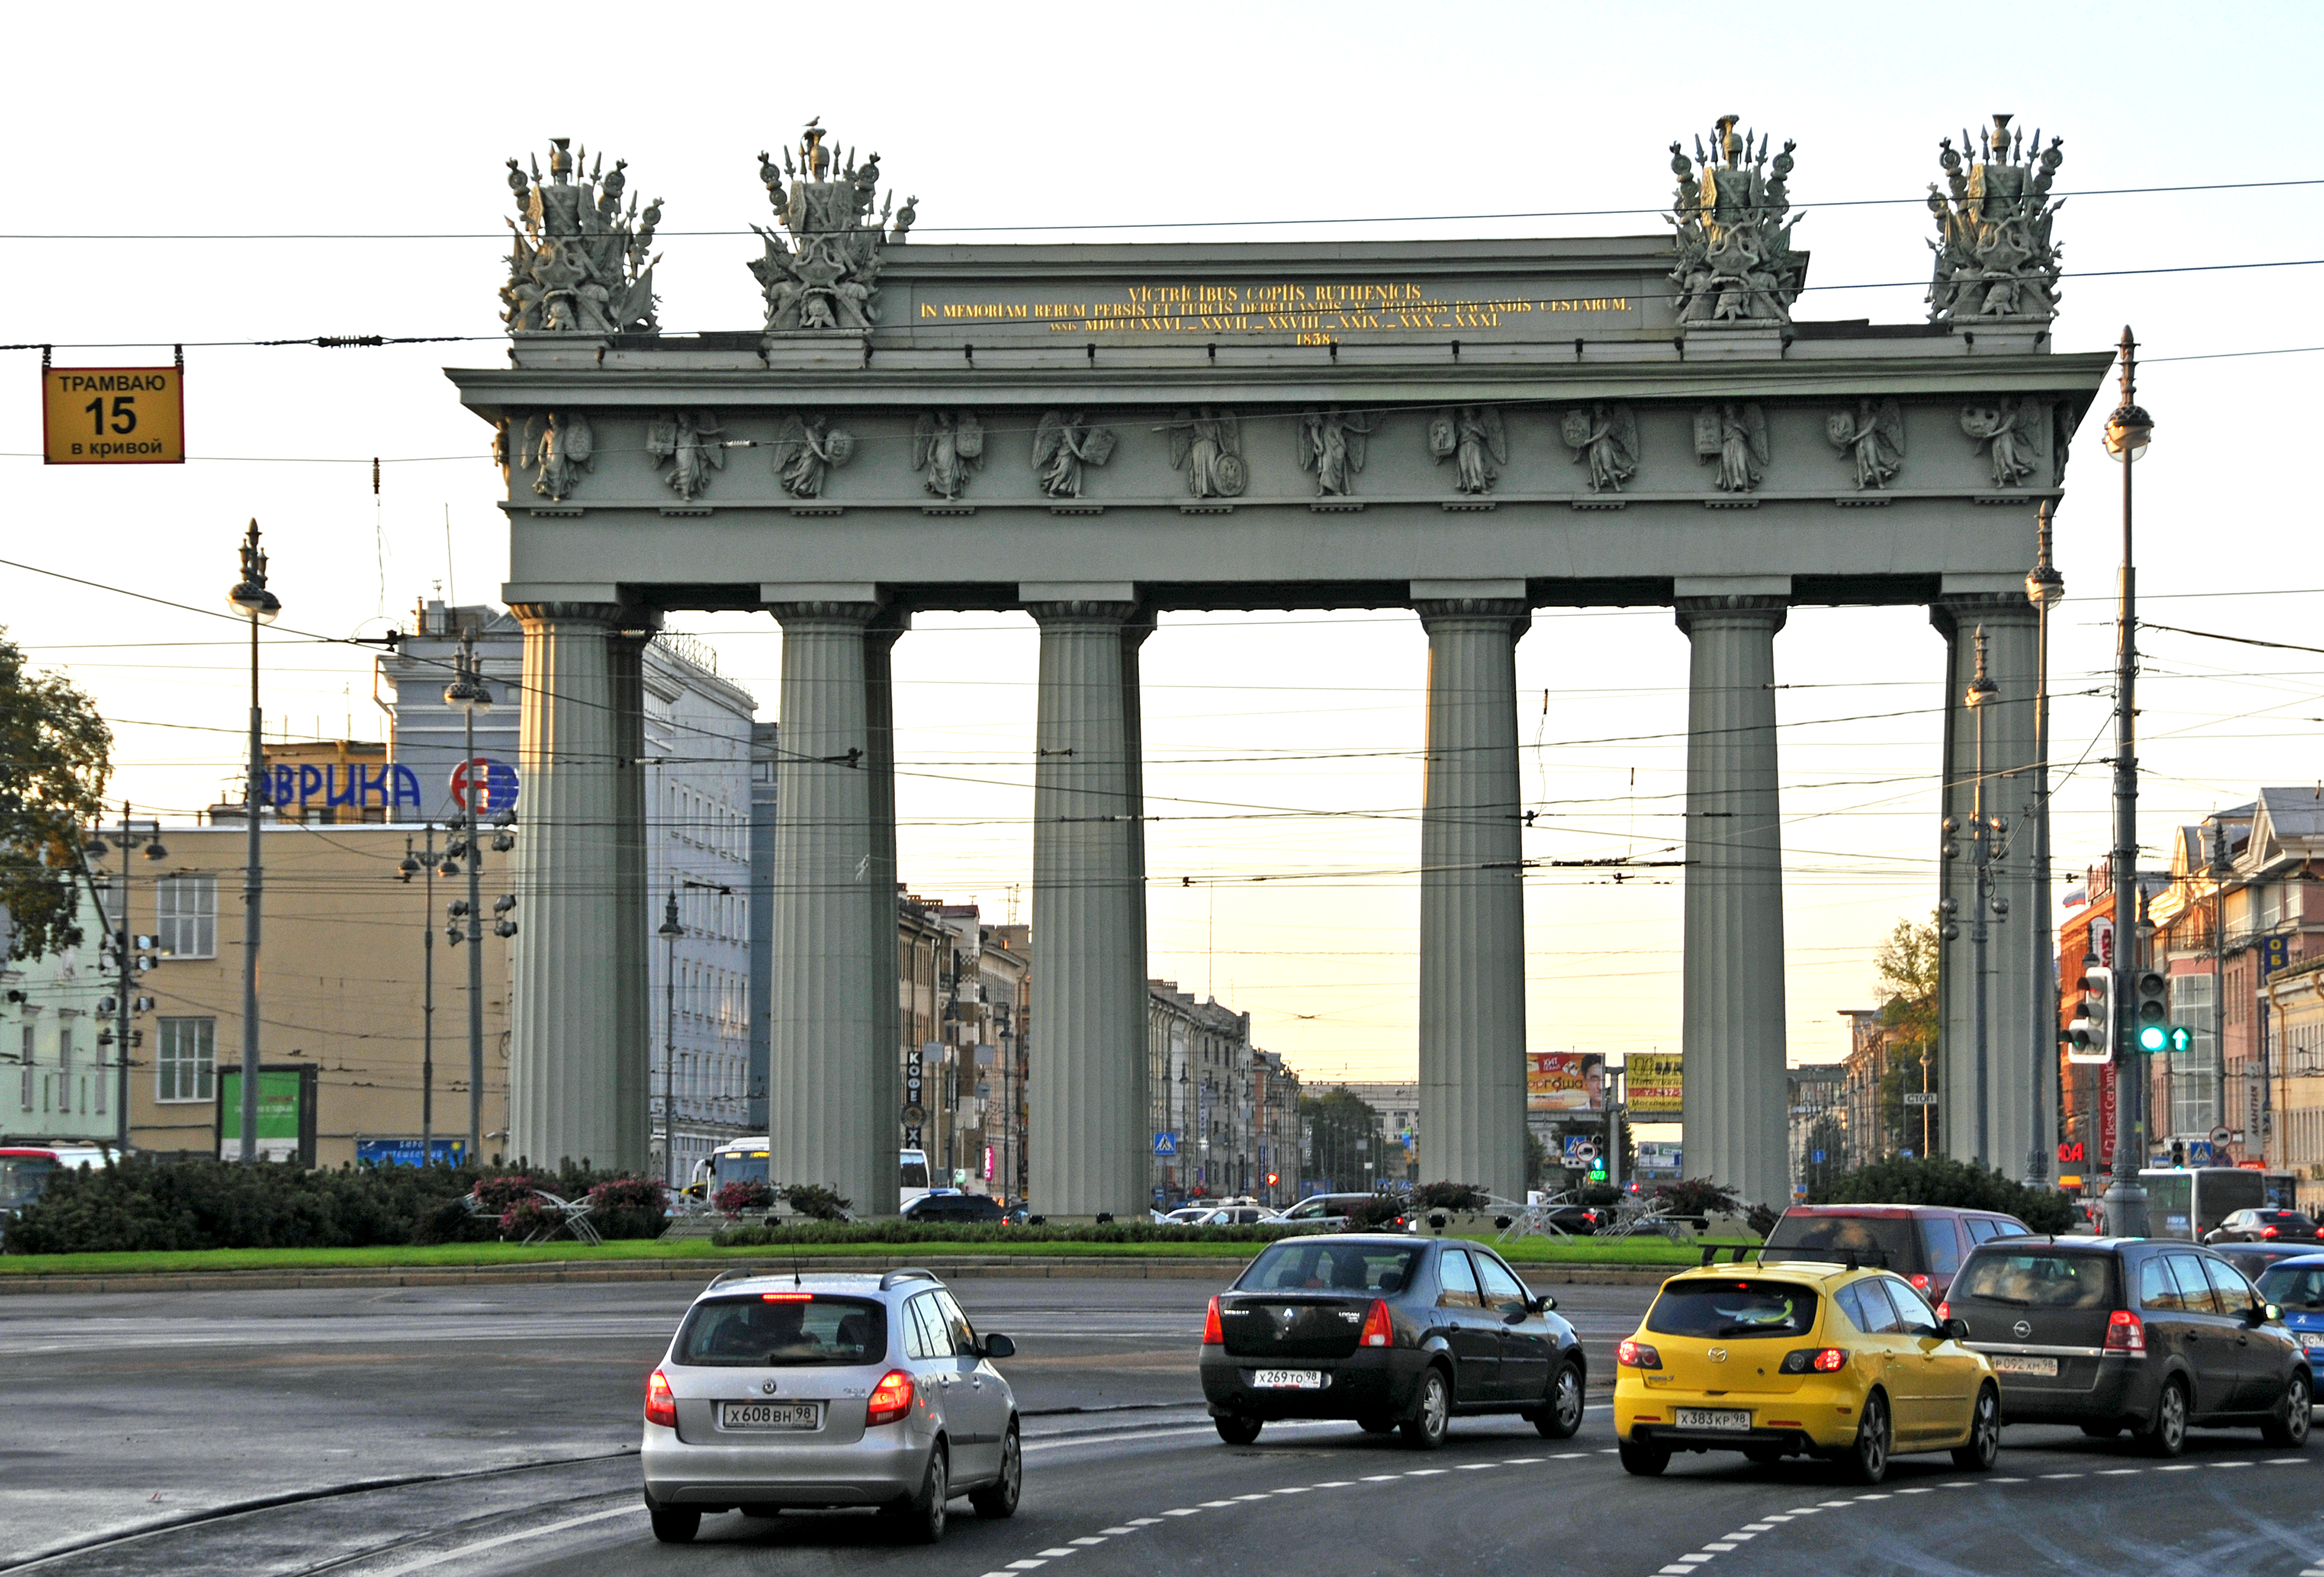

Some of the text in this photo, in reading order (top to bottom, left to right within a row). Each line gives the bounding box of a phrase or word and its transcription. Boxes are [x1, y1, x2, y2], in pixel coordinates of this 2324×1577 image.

[1315, 283, 1422, 300] RUTHENICIS
[920, 303, 937, 318] IN
[943, 302, 1028, 318] MEMORIAM
[1034, 304, 1086, 317] RERUM
[1093, 302, 1145, 317] PERSIS
[1152, 303, 1171, 316] ET
[1178, 300, 1233, 315] TURCIS
[59, 375, 166, 392] ТРАМВАЮ
[85, 396, 137, 435] 15
[907, 1052, 921, 1102] КОФЕ
[2104, 1111, 2115, 1135] Best
[1305, 1371, 1317, 1381] 98
[796, 1407, 811, 1419] 98
[1733, 1412, 1746, 1423] 98
